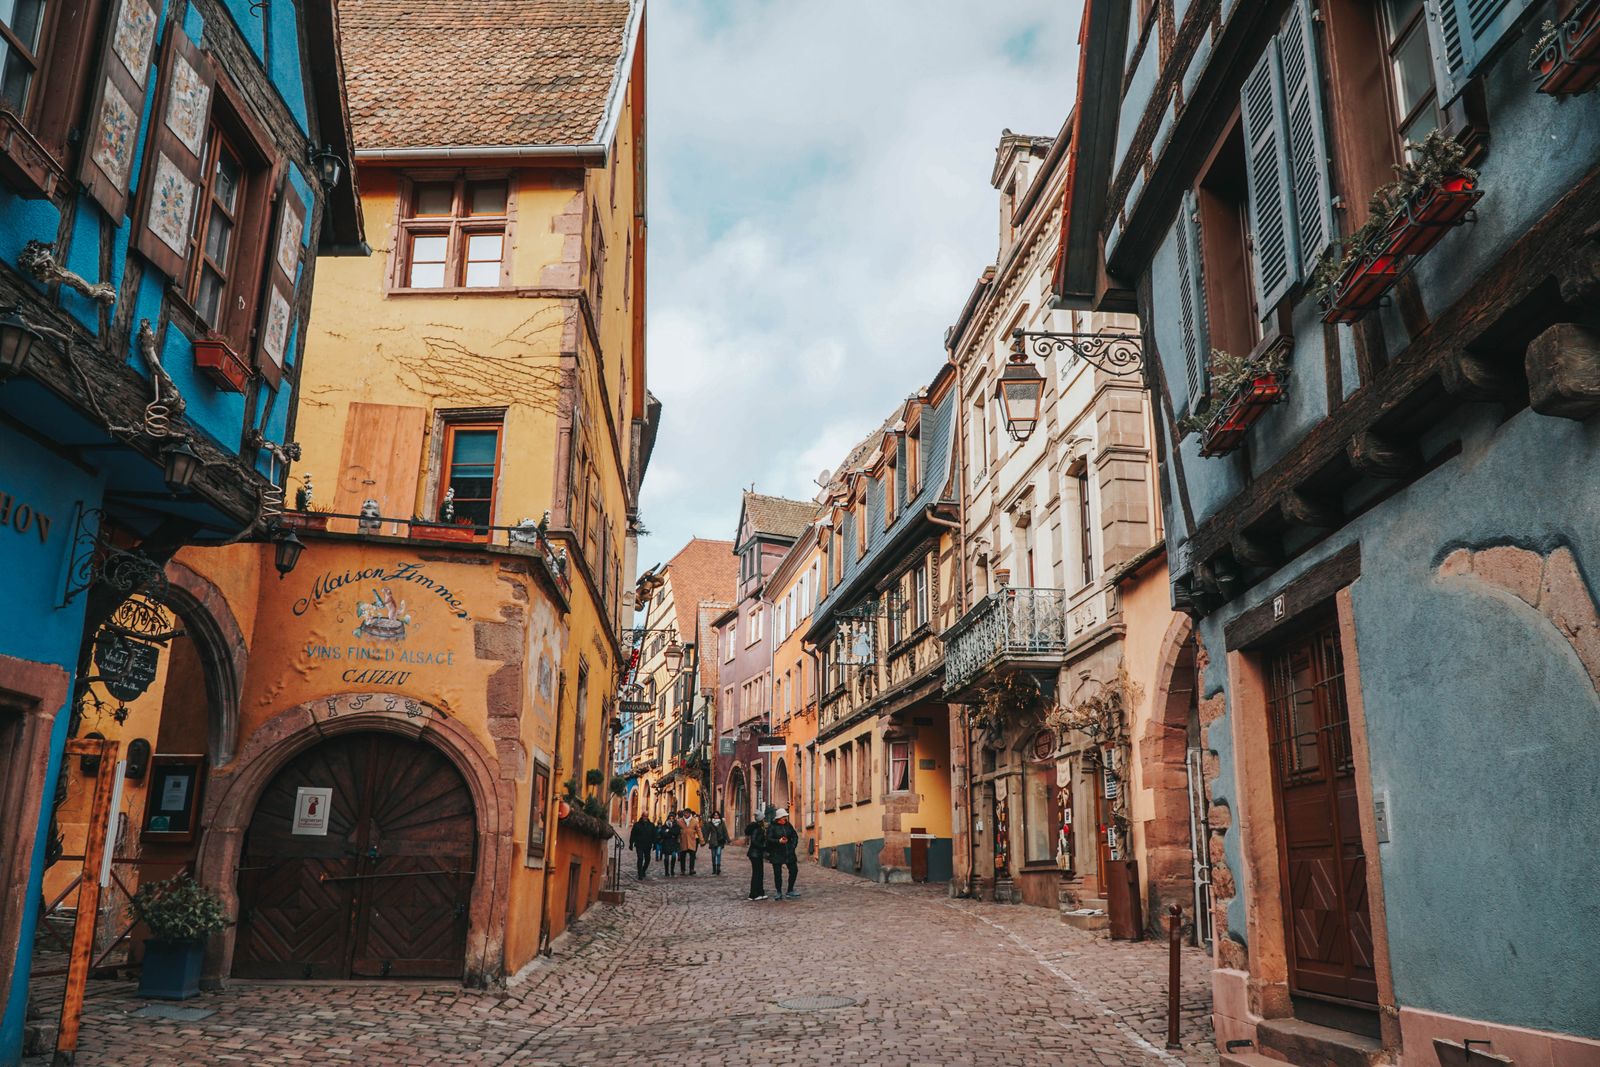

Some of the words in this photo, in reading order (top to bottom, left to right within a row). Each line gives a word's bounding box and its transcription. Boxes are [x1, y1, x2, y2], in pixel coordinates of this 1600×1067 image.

[292, 568, 385, 616] Maison
[1274, 599, 1283, 617] 12
[306, 645, 342, 660] VINS
[347, 646, 381, 662] FINS
[342, 669, 411, 686] CAVEAU
